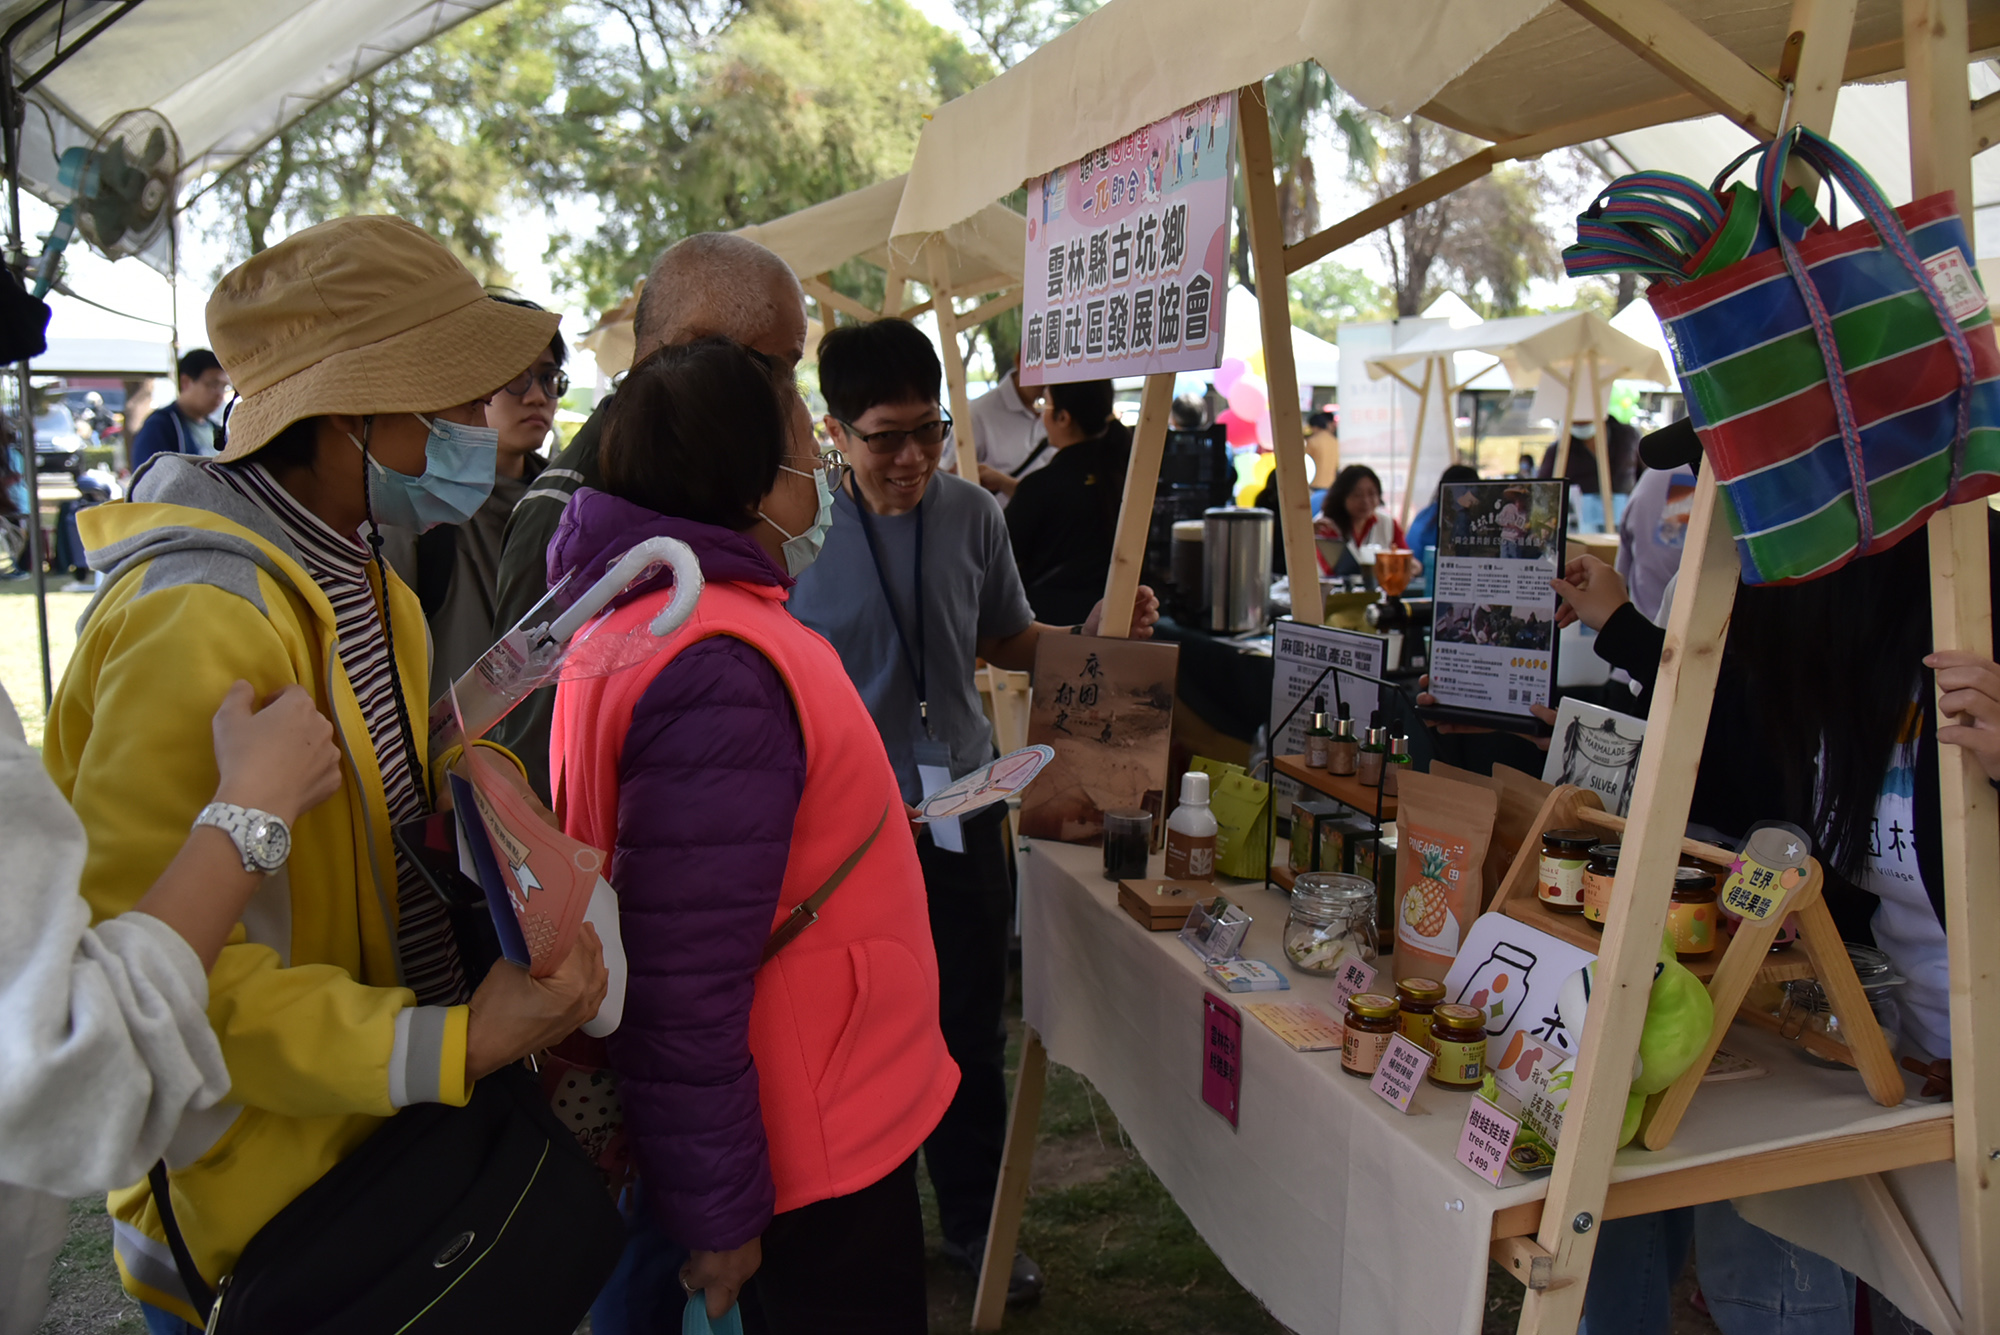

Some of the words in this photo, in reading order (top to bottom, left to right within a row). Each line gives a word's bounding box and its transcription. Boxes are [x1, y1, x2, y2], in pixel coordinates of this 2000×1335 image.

[1048, 203, 1187, 298] 雲林縣古坑鄉
[1026, 275, 1211, 365] 麻園社區發展協會
[1281, 638, 1353, 667] 麻園社區產品
[1584, 735, 1626, 757] MARMALADE
[1590, 775, 1618, 796] SILVER
[1408, 836, 1451, 862] PINEAPPLE
[1749, 867, 1775, 890] 世界
[1876, 867, 1915, 882] Village
[1725, 885, 1773, 918] 得獎果醬
[1344, 965, 1366, 989] 果乾
[1469, 1108, 1511, 1147] 樹蛙娃娃
[1468, 1131, 1484, 1149] tree
[1484, 1141, 1501, 1162] frog
